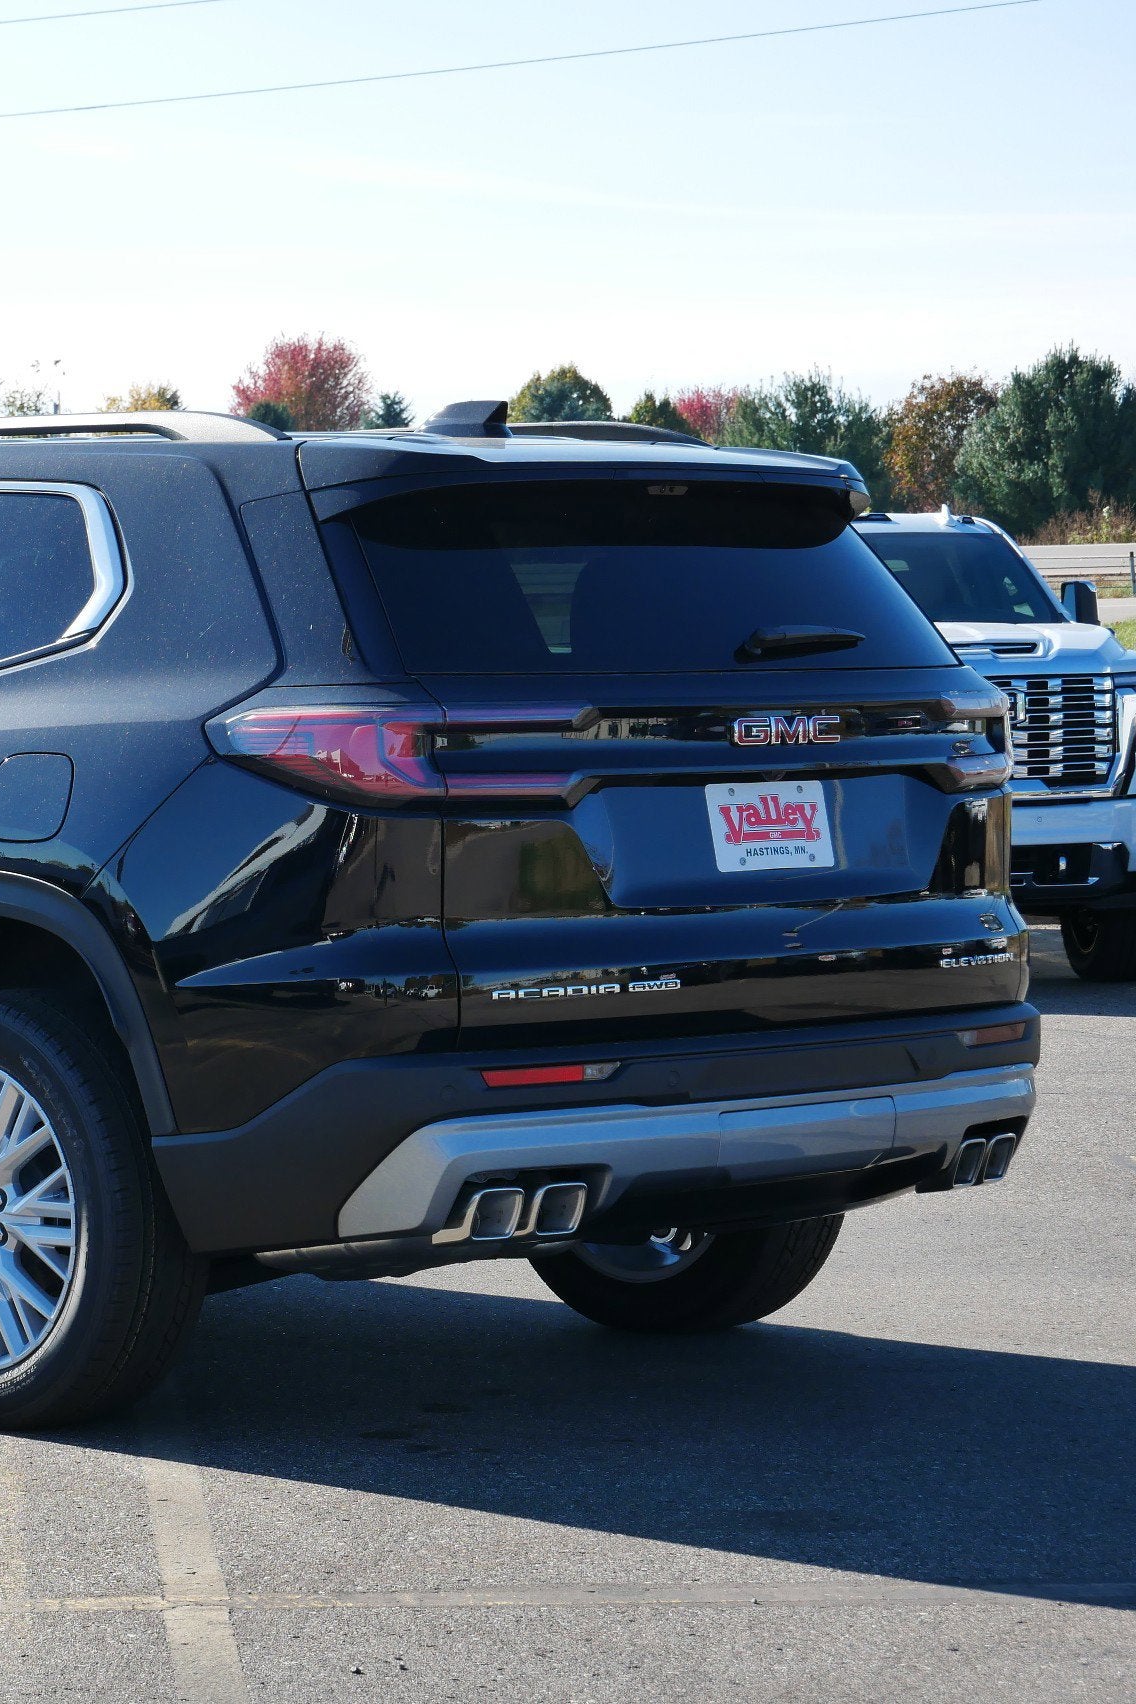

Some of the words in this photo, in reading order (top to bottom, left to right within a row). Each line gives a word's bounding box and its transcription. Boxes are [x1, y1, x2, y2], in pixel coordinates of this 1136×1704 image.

[733, 715, 841, 746] GMC
[718, 794, 819, 844] Valley
[746, 846, 793, 857] HASTINGS,
[794, 845, 809, 855] MN.
[940, 952, 1014, 968] ELEVATION
[492, 983, 621, 1000] ACADIA
[629, 979, 681, 992] AWD
